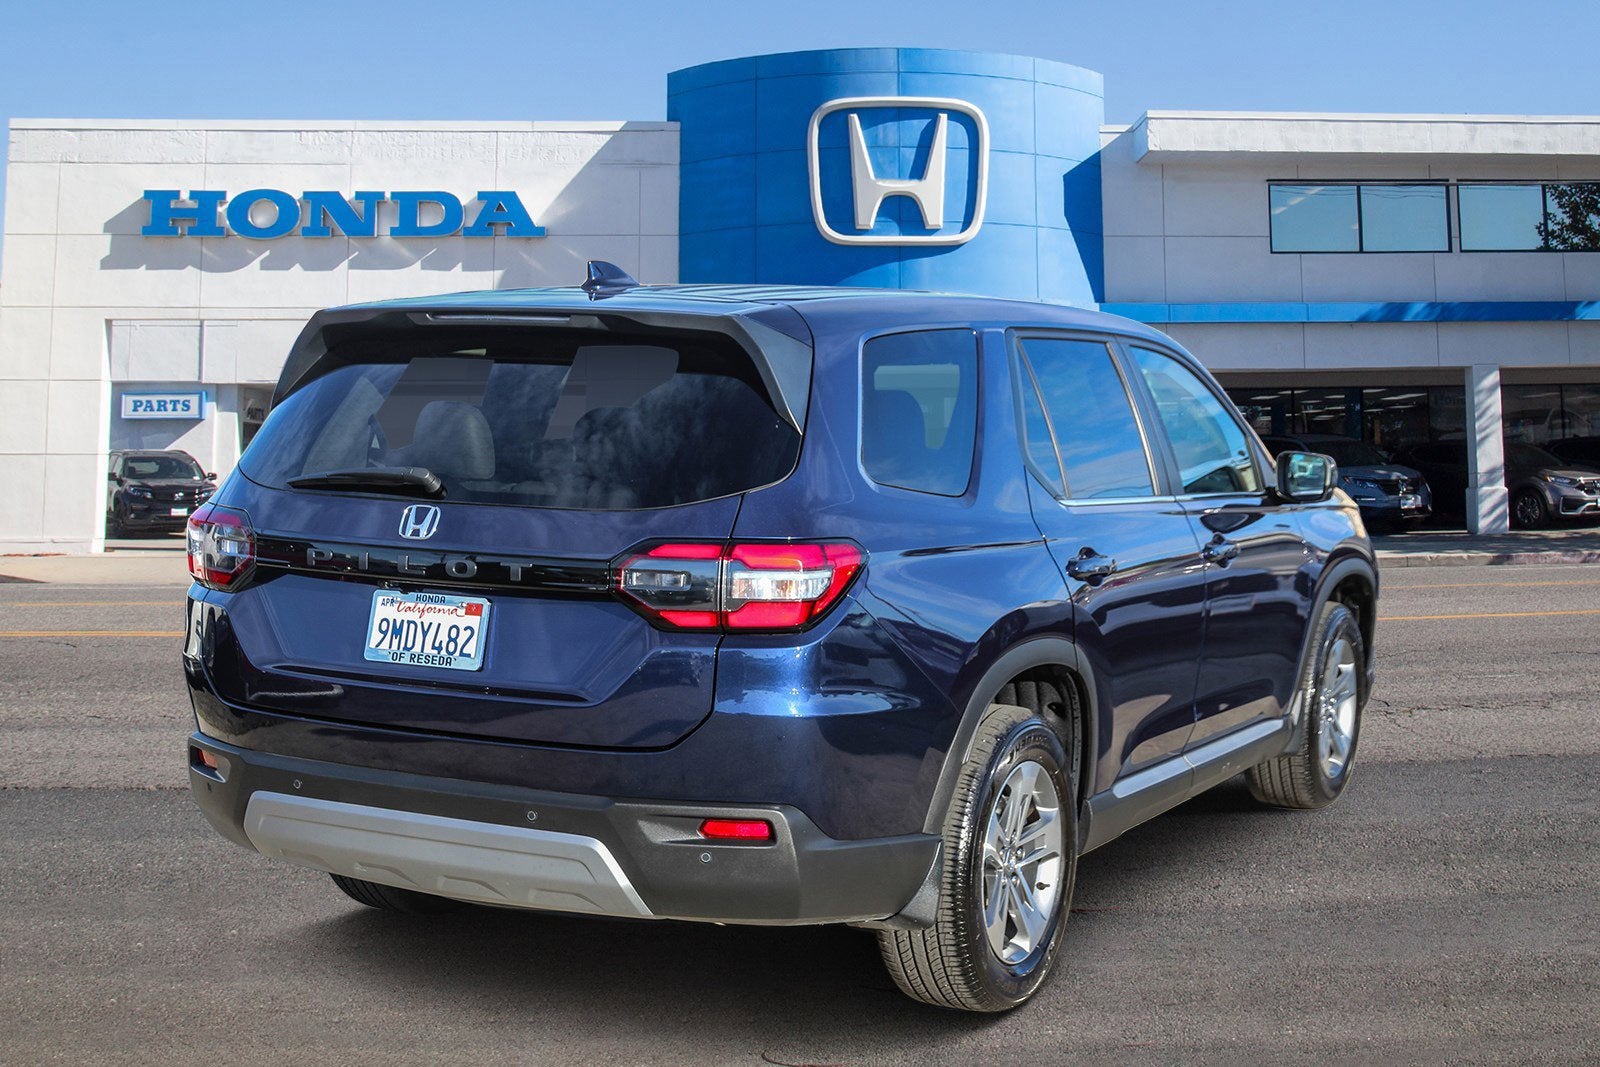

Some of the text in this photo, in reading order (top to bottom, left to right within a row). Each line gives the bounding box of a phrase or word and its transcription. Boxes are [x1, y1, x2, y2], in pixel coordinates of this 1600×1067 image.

[141, 188, 548, 240] HONDA
[131, 399, 191, 412] PARTS
[306, 547, 533, 582] PILOT
[380, 598, 395, 608] APR
[415, 593, 447, 604] HONDA
[396, 600, 465, 619] California
[375, 617, 476, 658] 9MDY482
[391, 651, 452, 667] OF RESEDA
